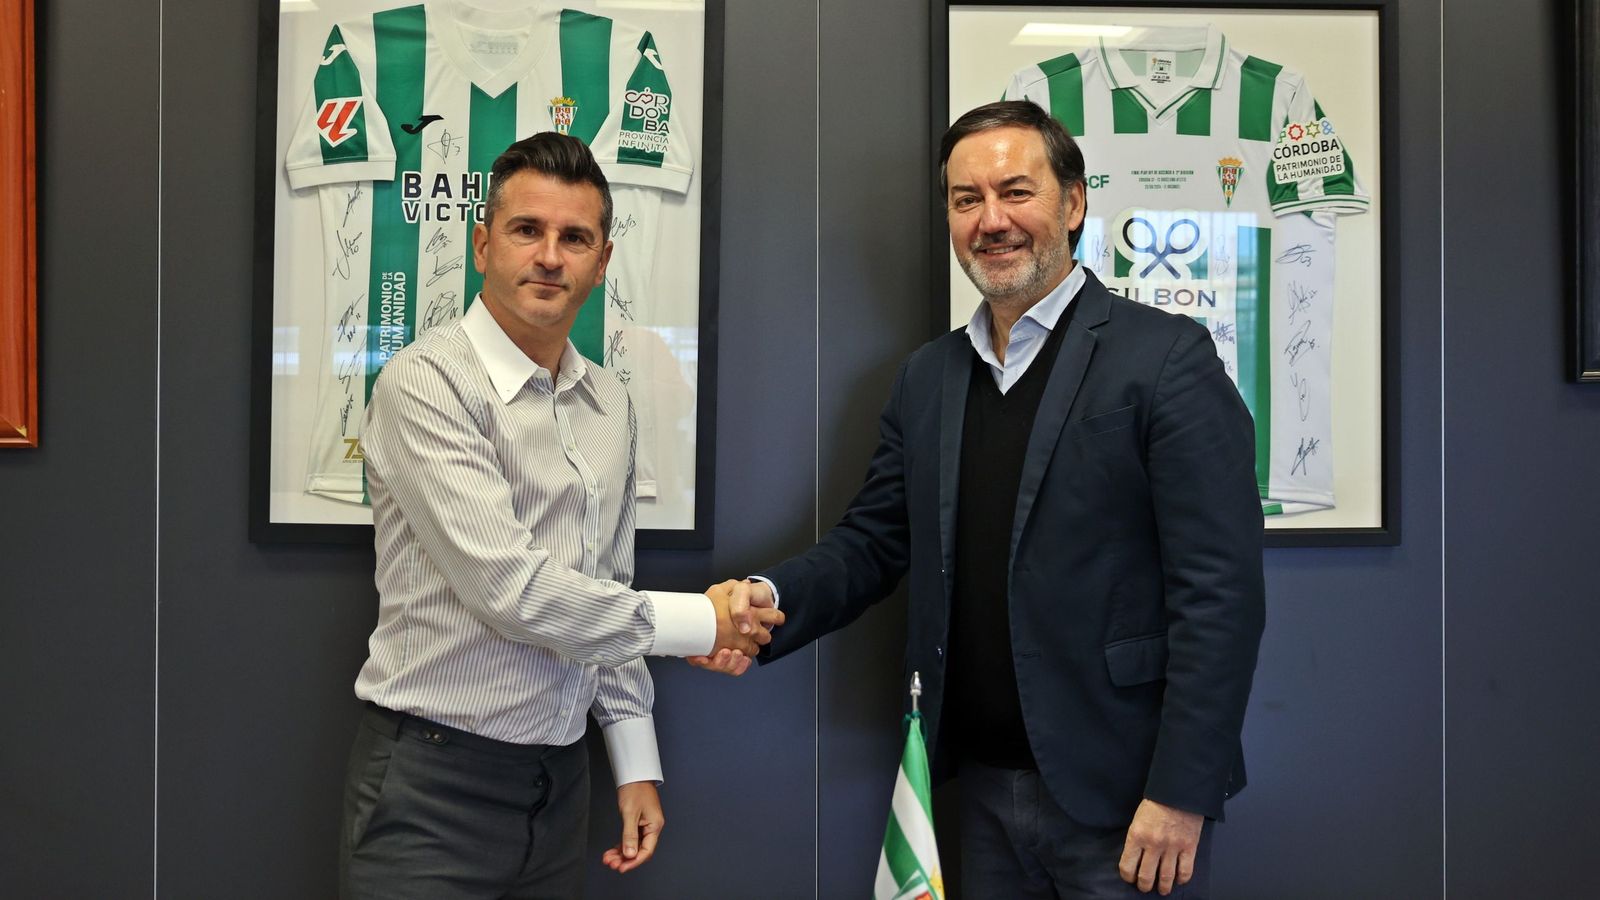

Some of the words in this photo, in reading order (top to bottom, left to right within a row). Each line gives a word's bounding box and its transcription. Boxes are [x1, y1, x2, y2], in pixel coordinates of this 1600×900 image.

[645, 120, 670, 133] BA
[618, 139, 668, 152] INFINITA
[619, 131, 669, 144] PROVINCIA
[1273, 138, 1340, 160] CÓRDOBA
[1276, 157, 1328, 172] PATRIMONIO
[1329, 154, 1341, 164] DE
[1277, 172, 1289, 181] LA
[1290, 163, 1342, 179] HUMANIDAD
[404, 173, 493, 199] BAH
[379, 281, 393, 361] PATRIMONIO
[391, 271, 406, 355] UMANIDAD
